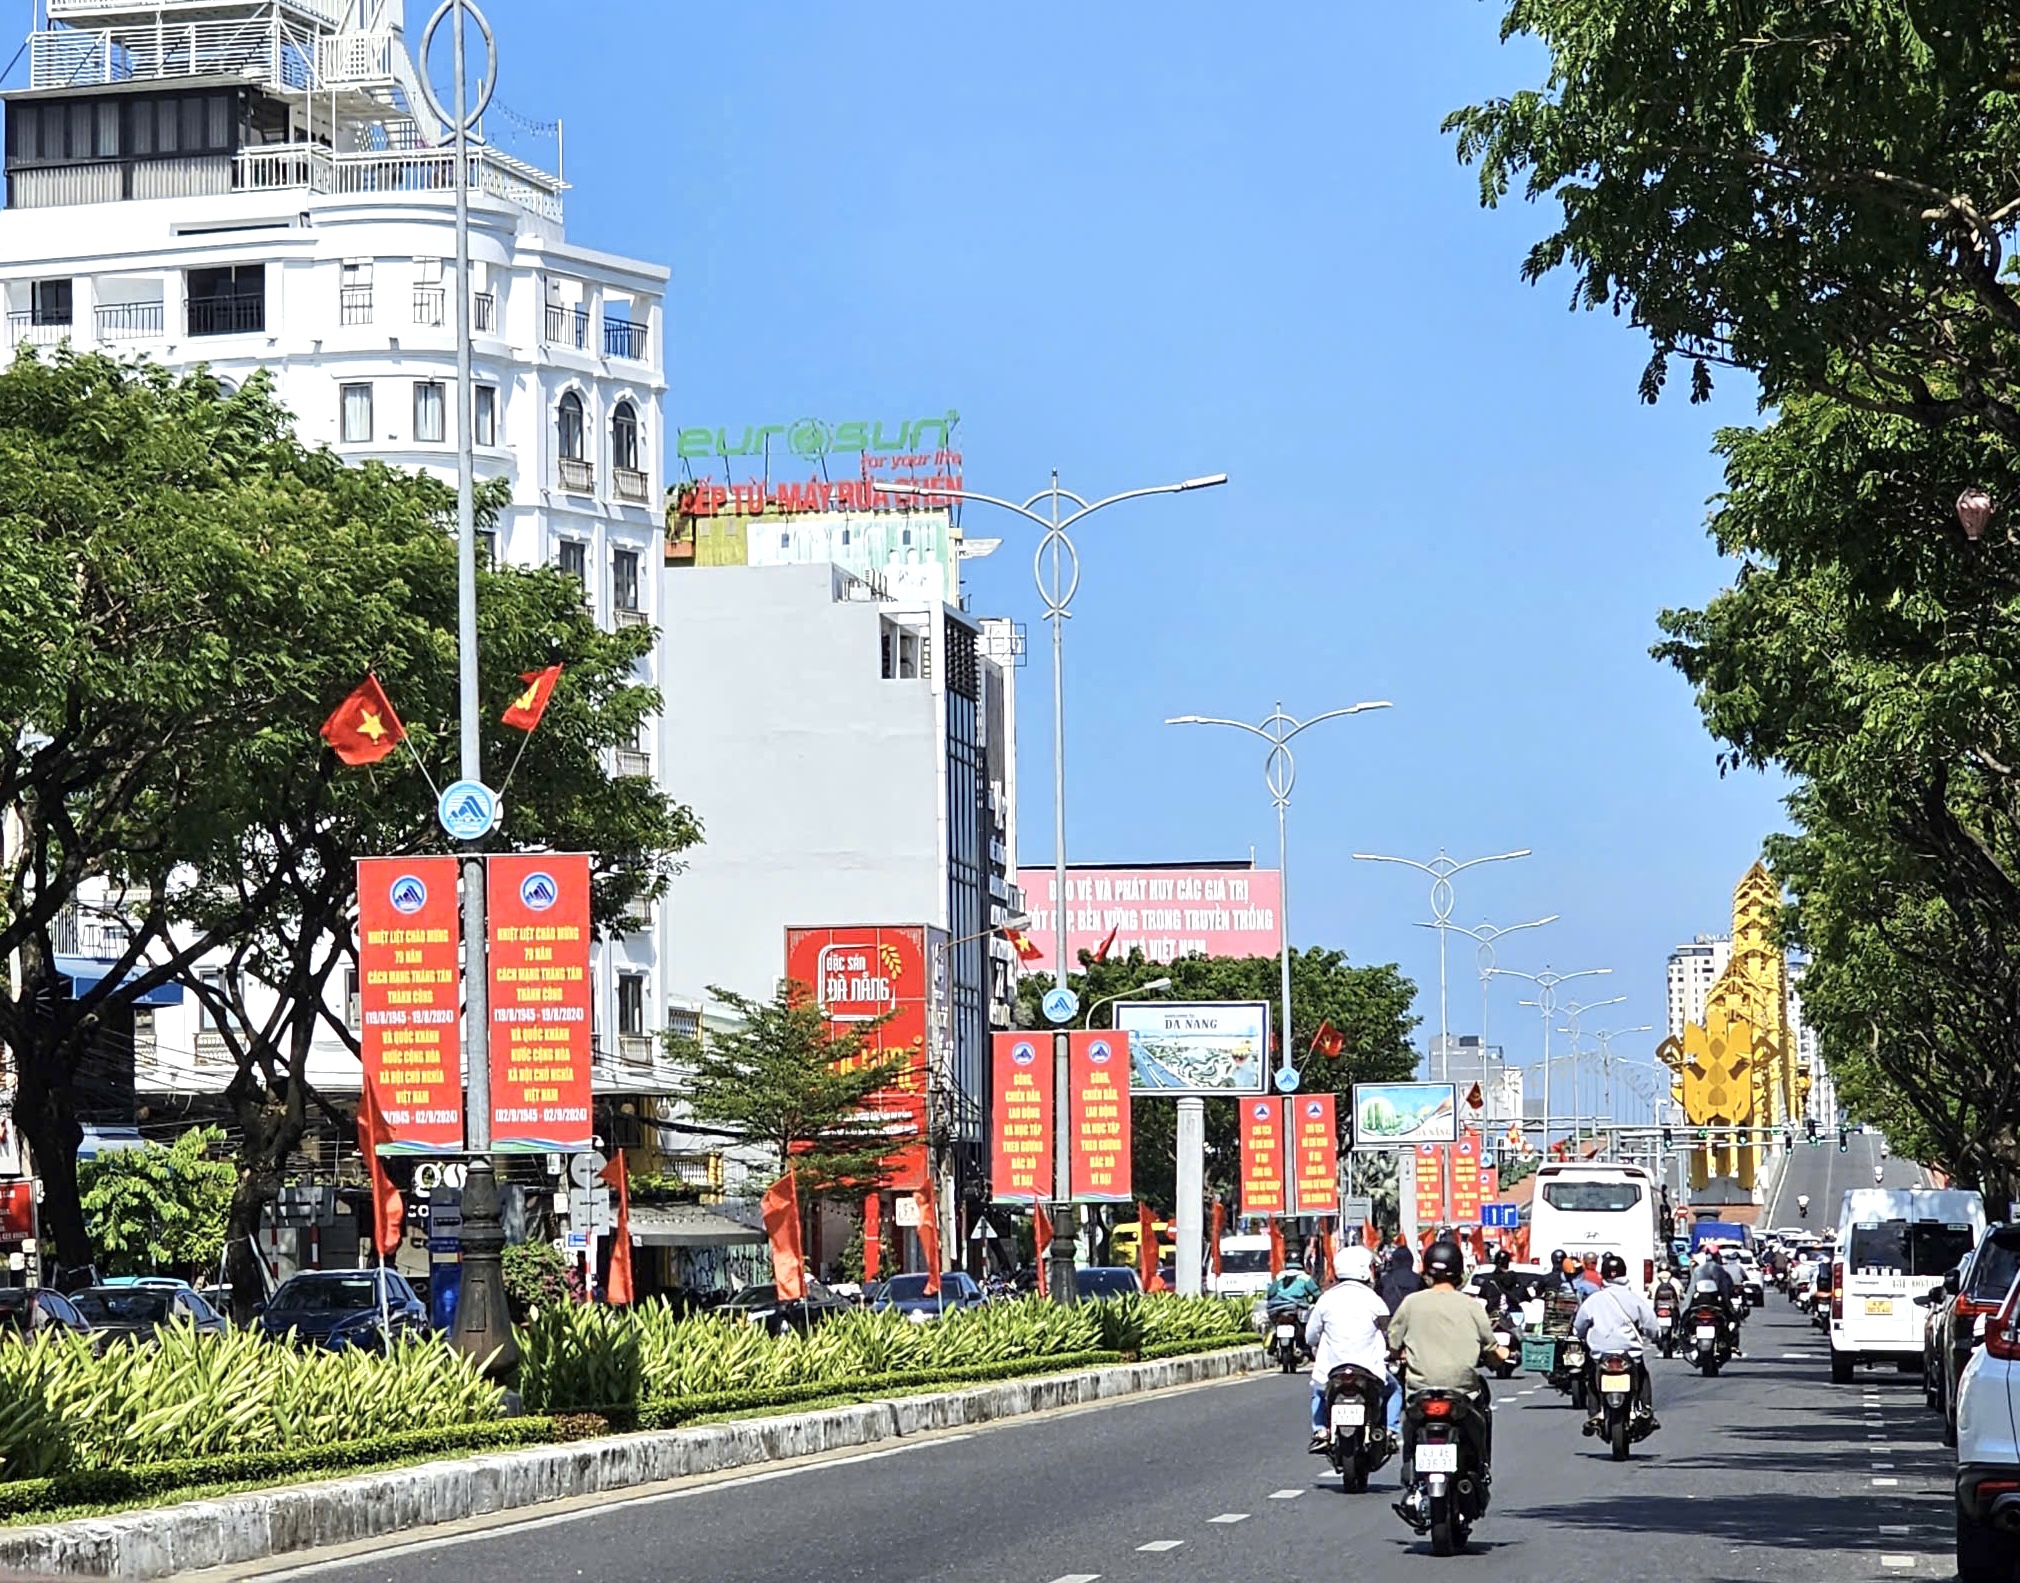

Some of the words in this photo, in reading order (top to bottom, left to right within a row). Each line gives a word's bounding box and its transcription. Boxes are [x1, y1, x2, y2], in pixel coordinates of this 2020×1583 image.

[1049, 878, 1074, 901] BO
[1095, 876, 1112, 901] VÀ
[1115, 876, 1147, 901] PHÁT
[1149, 879, 1174, 901] HUY
[1177, 876, 1202, 901] CÁC
[1204, 876, 1227, 901] GIÁ
[1228, 879, 1249, 905] TRỊ
[1077, 902, 1102, 931] BỀN
[1103, 906, 1139, 932] VỮNG
[1142, 909, 1182, 931] TRONG
[1184, 902, 1230, 931] TRUYỀN
[1232, 902, 1274, 931] THỐNG
[1149, 936, 1177, 965] VIỆT
[826, 973, 848, 1001] ĐÀ
[1165, 1019, 1181, 1029] DA
[1185, 1019, 1218, 1029] NANG
